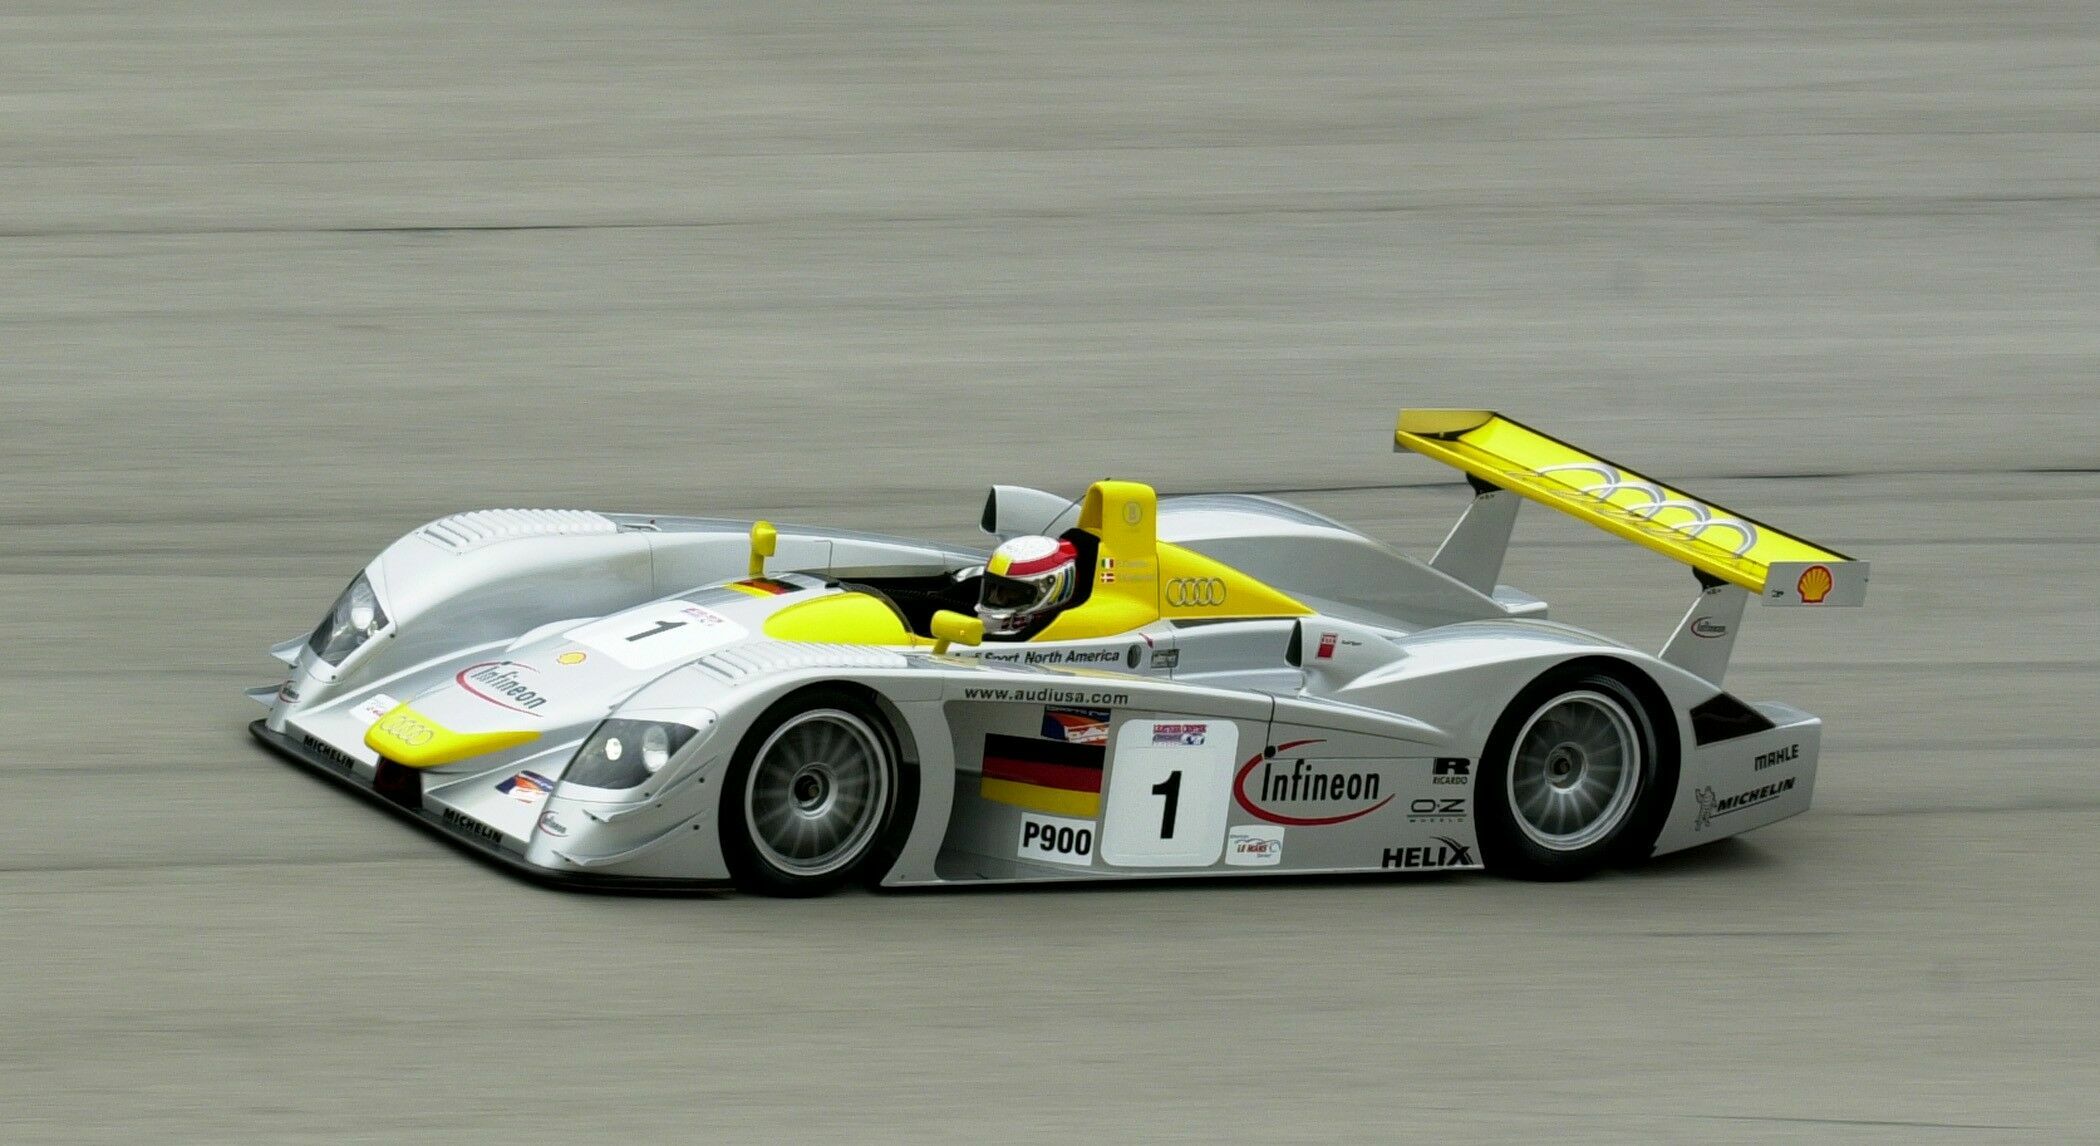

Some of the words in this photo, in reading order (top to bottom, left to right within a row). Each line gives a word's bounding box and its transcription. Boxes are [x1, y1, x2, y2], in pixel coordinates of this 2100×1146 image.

[625, 620, 688, 642] 1
[1025, 651, 1062, 664] North
[1066, 649, 1120, 663] America
[470, 661, 547, 709] Infineon
[965, 687, 1128, 704] www.audiusa.com
[304, 734, 355, 770] MICHELIN
[1754, 744, 1799, 772] MAHLE
[1261, 745, 1380, 801] Infineon
[1433, 777, 1468, 785] RICARDO
[1152, 771, 1182, 839] 1
[1717, 777, 1796, 812] MICHELIN
[442, 807, 503, 843] MICHELIN
[1023, 821, 1092, 855] P900
[1382, 837, 1474, 869] HELIX
